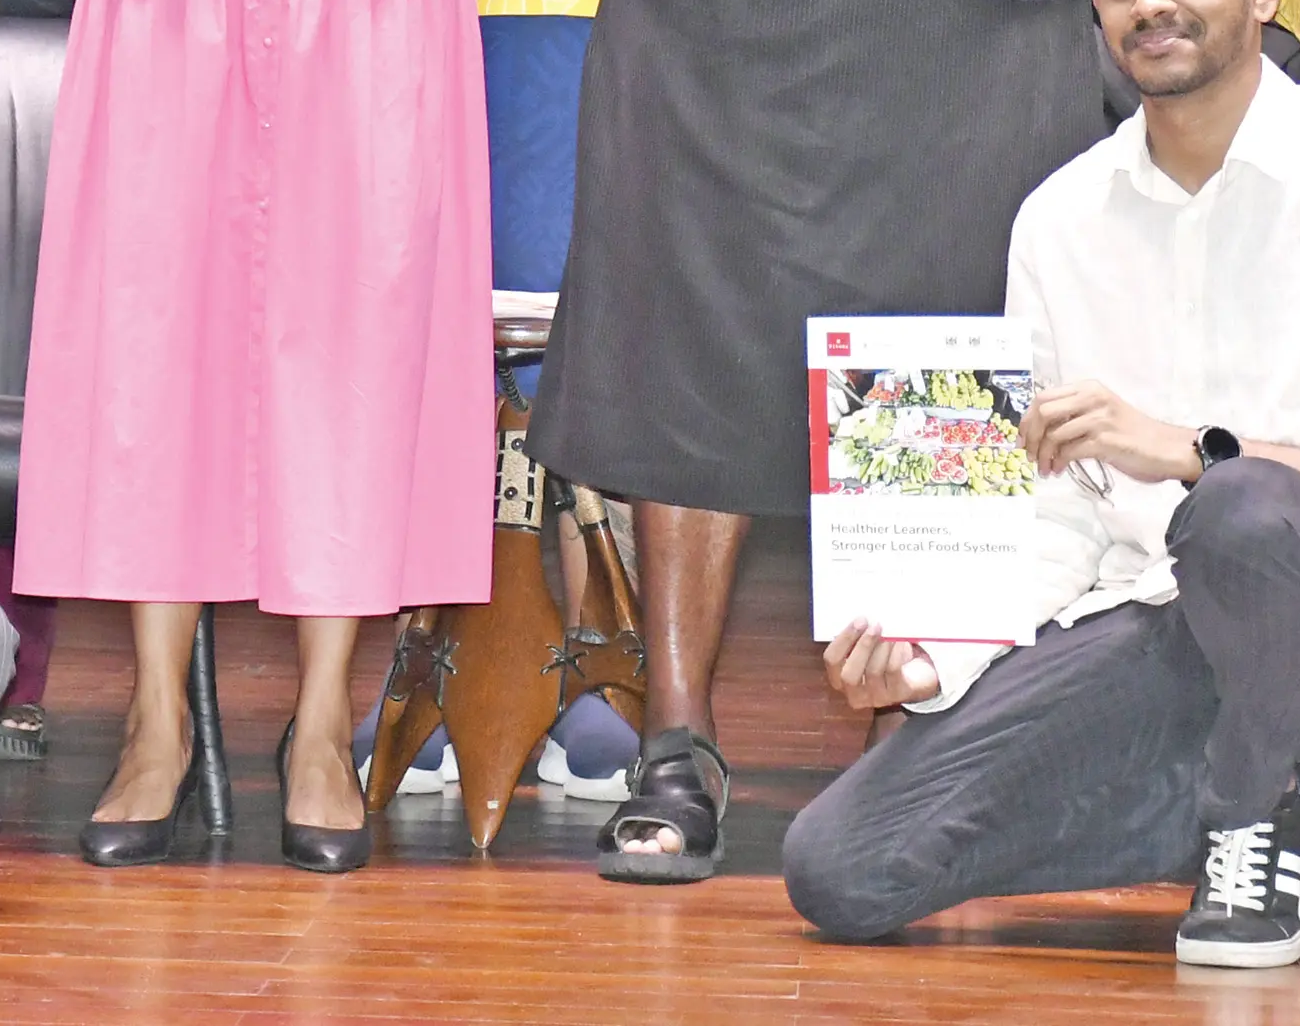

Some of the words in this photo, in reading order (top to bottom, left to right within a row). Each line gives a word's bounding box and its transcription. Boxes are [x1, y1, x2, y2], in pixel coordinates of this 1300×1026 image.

[830, 522, 890, 535] Healthier
[893, 523, 952, 536] Learners,
[831, 539, 887, 554] Stronger
[890, 540, 925, 552] Local
[928, 540, 960, 553] Food
[963, 541, 1017, 555] Systems
